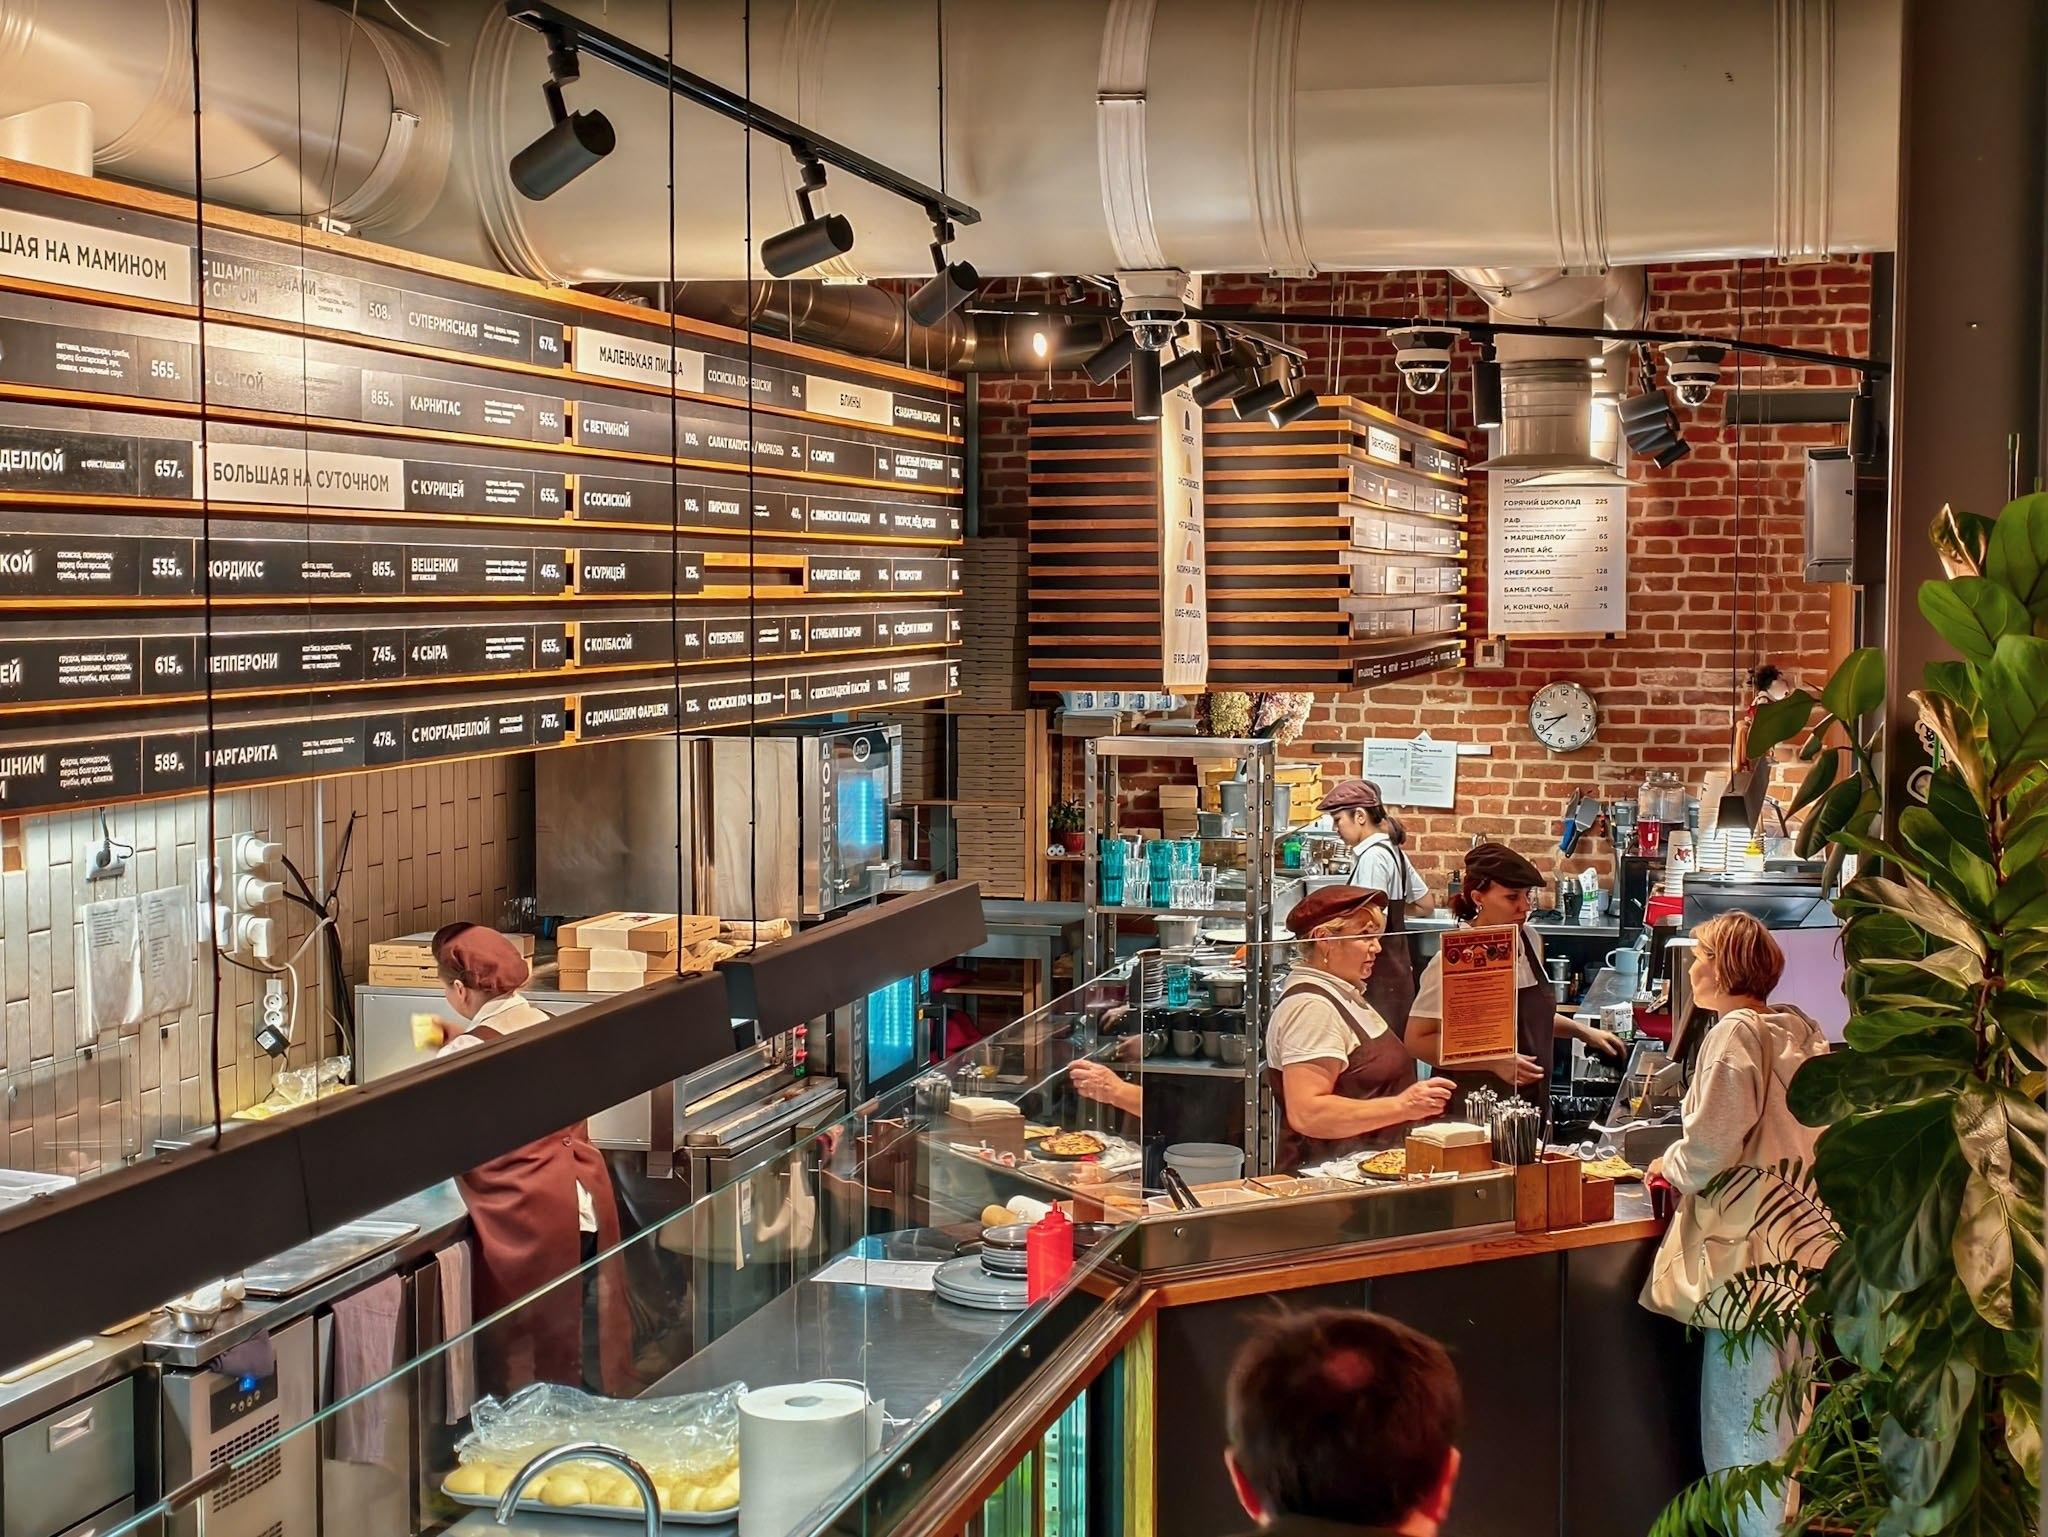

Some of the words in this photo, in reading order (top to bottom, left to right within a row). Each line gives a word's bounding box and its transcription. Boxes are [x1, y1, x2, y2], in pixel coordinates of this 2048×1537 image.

[46, 239, 71, 265] НА
[77, 245, 167, 281] МАМИНОМ
[408, 311, 478, 338] СУПЕРМЯСНАЯ
[599, 346, 653, 371] МАЛЕНЬКАЯ
[654, 356, 684, 376] ПИЦА
[707, 369, 737, 387] СОСИСКА
[737, 375, 772, 392] ПО-ЕШСКИ
[410, 395, 461, 416] КАРНИТАС
[583, 419, 590, 433] С
[590, 420, 630, 437] ВЕТЧИНОЙ
[728, 438, 755, 453] КАПУСТ
[0, 448, 64, 473] ДЕЛЛОЙ
[213, 462, 289, 486] БОЛЬШАЯ
[293, 468, 313, 487] НА
[316, 470, 390, 493] СУТОЧНОМ
[411, 479, 419, 495] С
[420, 479, 465, 499] КУРИЦЕЙ
[583, 491, 590, 505] С
[590, 491, 631, 508] СОСИСКОЙ
[1504, 498, 1539, 507] ГОРЯЧИЙ
[1537, 545, 1553, 554] АЙС
[0, 549, 34, 574] КОЙ
[411, 557, 459, 573] ВЕШЕНКИ
[584, 565, 591, 579] С
[591, 563, 626, 582] КУРИЦЕЙ
[1513, 603, 1552, 611] КОНЕЧНО,
[1553, 602, 1569, 610] ЧАЙ
[584, 638, 591, 652] С
[591, 633, 633, 652] КОЛБАСОЙ
[411, 646, 419, 662] 4
[420, 644, 449, 661] СЫРА
[0, 659, 21, 684] ЕЙ
[1549, 691, 1556, 699] 11
[1561, 688, 1569, 696] 12
[585, 711, 592, 725] С
[592, 705, 637, 726] ДОМАШНИМ
[637, 703, 669, 719] ФАРШЕМ
[1535, 711, 1542, 719] 9
[1584, 714, 1592, 722] 3
[411, 729, 420, 743] С
[420, 716, 491, 742] МОРТАДЕЛЛОЙ
[1546, 733, 1553, 741] 7
[1570, 734, 1578, 742] 5
[1558, 737, 1565, 745] 6
[822, 742, 832, 906] BAKERTOP
